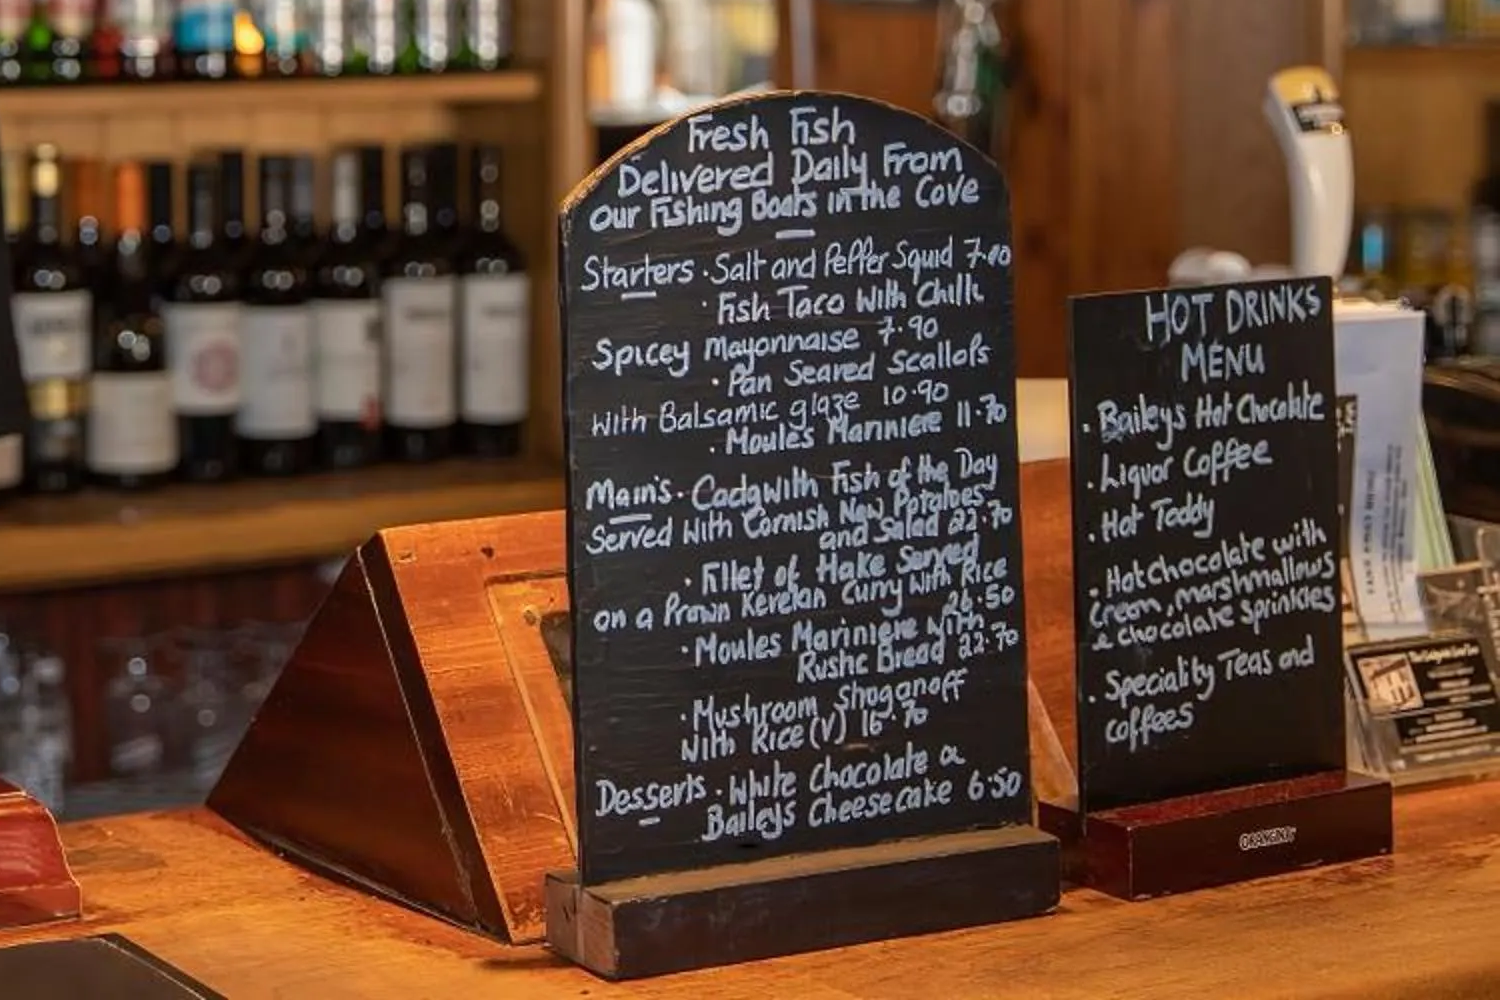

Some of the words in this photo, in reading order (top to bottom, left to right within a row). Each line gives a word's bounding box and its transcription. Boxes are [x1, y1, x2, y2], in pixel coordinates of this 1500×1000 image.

[688, 113, 769, 153] Fresh
[789, 106, 855, 145] Fish
[618, 150, 773, 197] Delivered
[791, 144, 867, 188] Daily
[883, 142, 962, 178] From
[651, 196, 742, 236] Fishing
[751, 187, 817, 220] Boats
[915, 174, 979, 208] Cove
[581, 253, 694, 290] Starters
[710, 249, 766, 284] Salt
[771, 248, 815, 280] and
[892, 235, 952, 285] Squid
[718, 291, 770, 325] Fish
[777, 285, 844, 318] Taco
[1145, 292, 1214, 342] HOT
[1226, 284, 1321, 334] DRINKS
[591, 337, 690, 377] Spicey
[878, 315, 938, 346] 7.90
[1181, 342, 1265, 383] MENU
[728, 362, 772, 397] Pan
[784, 352, 875, 386] Seared
[659, 400, 779, 433] Balsamic
[789, 391, 861, 430] glaze
[883, 379, 949, 405] 10.90
[726, 420, 815, 455] Moules
[827, 411, 942, 444] Mariniere
[1097, 393, 1187, 450] Baileys
[1196, 391, 1233, 429] Hot
[1236, 380, 1325, 424] Chocolate
[691, 466, 819, 511] Cadgwith
[832, 460, 880, 495] Fish
[888, 456, 911, 488] of
[918, 453, 949, 484] the
[954, 447, 998, 491] Day
[1100, 453, 1174, 499] Liquor
[1183, 438, 1273, 486] Coffee
[586, 516, 673, 554] Served
[742, 503, 829, 539] Cornish
[840, 497, 884, 525] New
[893, 481, 986, 517] Potatoes
[820, 521, 869, 550] and
[1101, 503, 1144, 543] Hot
[1150, 491, 1215, 539] Toddy
[702, 556, 764, 596] Fillet
[774, 554, 800, 590] of
[816, 551, 887, 584] Hake
[896, 532, 979, 574] Served
[1106, 559, 1147, 598] Hot
[1272, 518, 1327, 555] with
[593, 609, 627, 632] on
[635, 607, 654, 631] a
[663, 591, 731, 627] Prawn
[841, 578, 903, 617] Curry
[961, 557, 1008, 587] Rice
[1117, 605, 1234, 647] chocolate
[1241, 586, 1335, 635] sprinkles
[695, 626, 781, 667] Moules
[792, 617, 918, 651] Mariniere
[797, 649, 869, 683] Rustic
[877, 641, 945, 673] Bread
[1104, 655, 1215, 709] Speciality
[1217, 648, 1273, 681] Teas
[1279, 634, 1315, 670] and
[693, 693, 817, 732] Mushroom
[751, 722, 805, 755] Rice
[596, 773, 706, 817] Desserts
[729, 759, 797, 805] White
[809, 742, 928, 793] Chocolate
[702, 801, 796, 840] Baileys
[809, 778, 952, 827] Cheesecake
